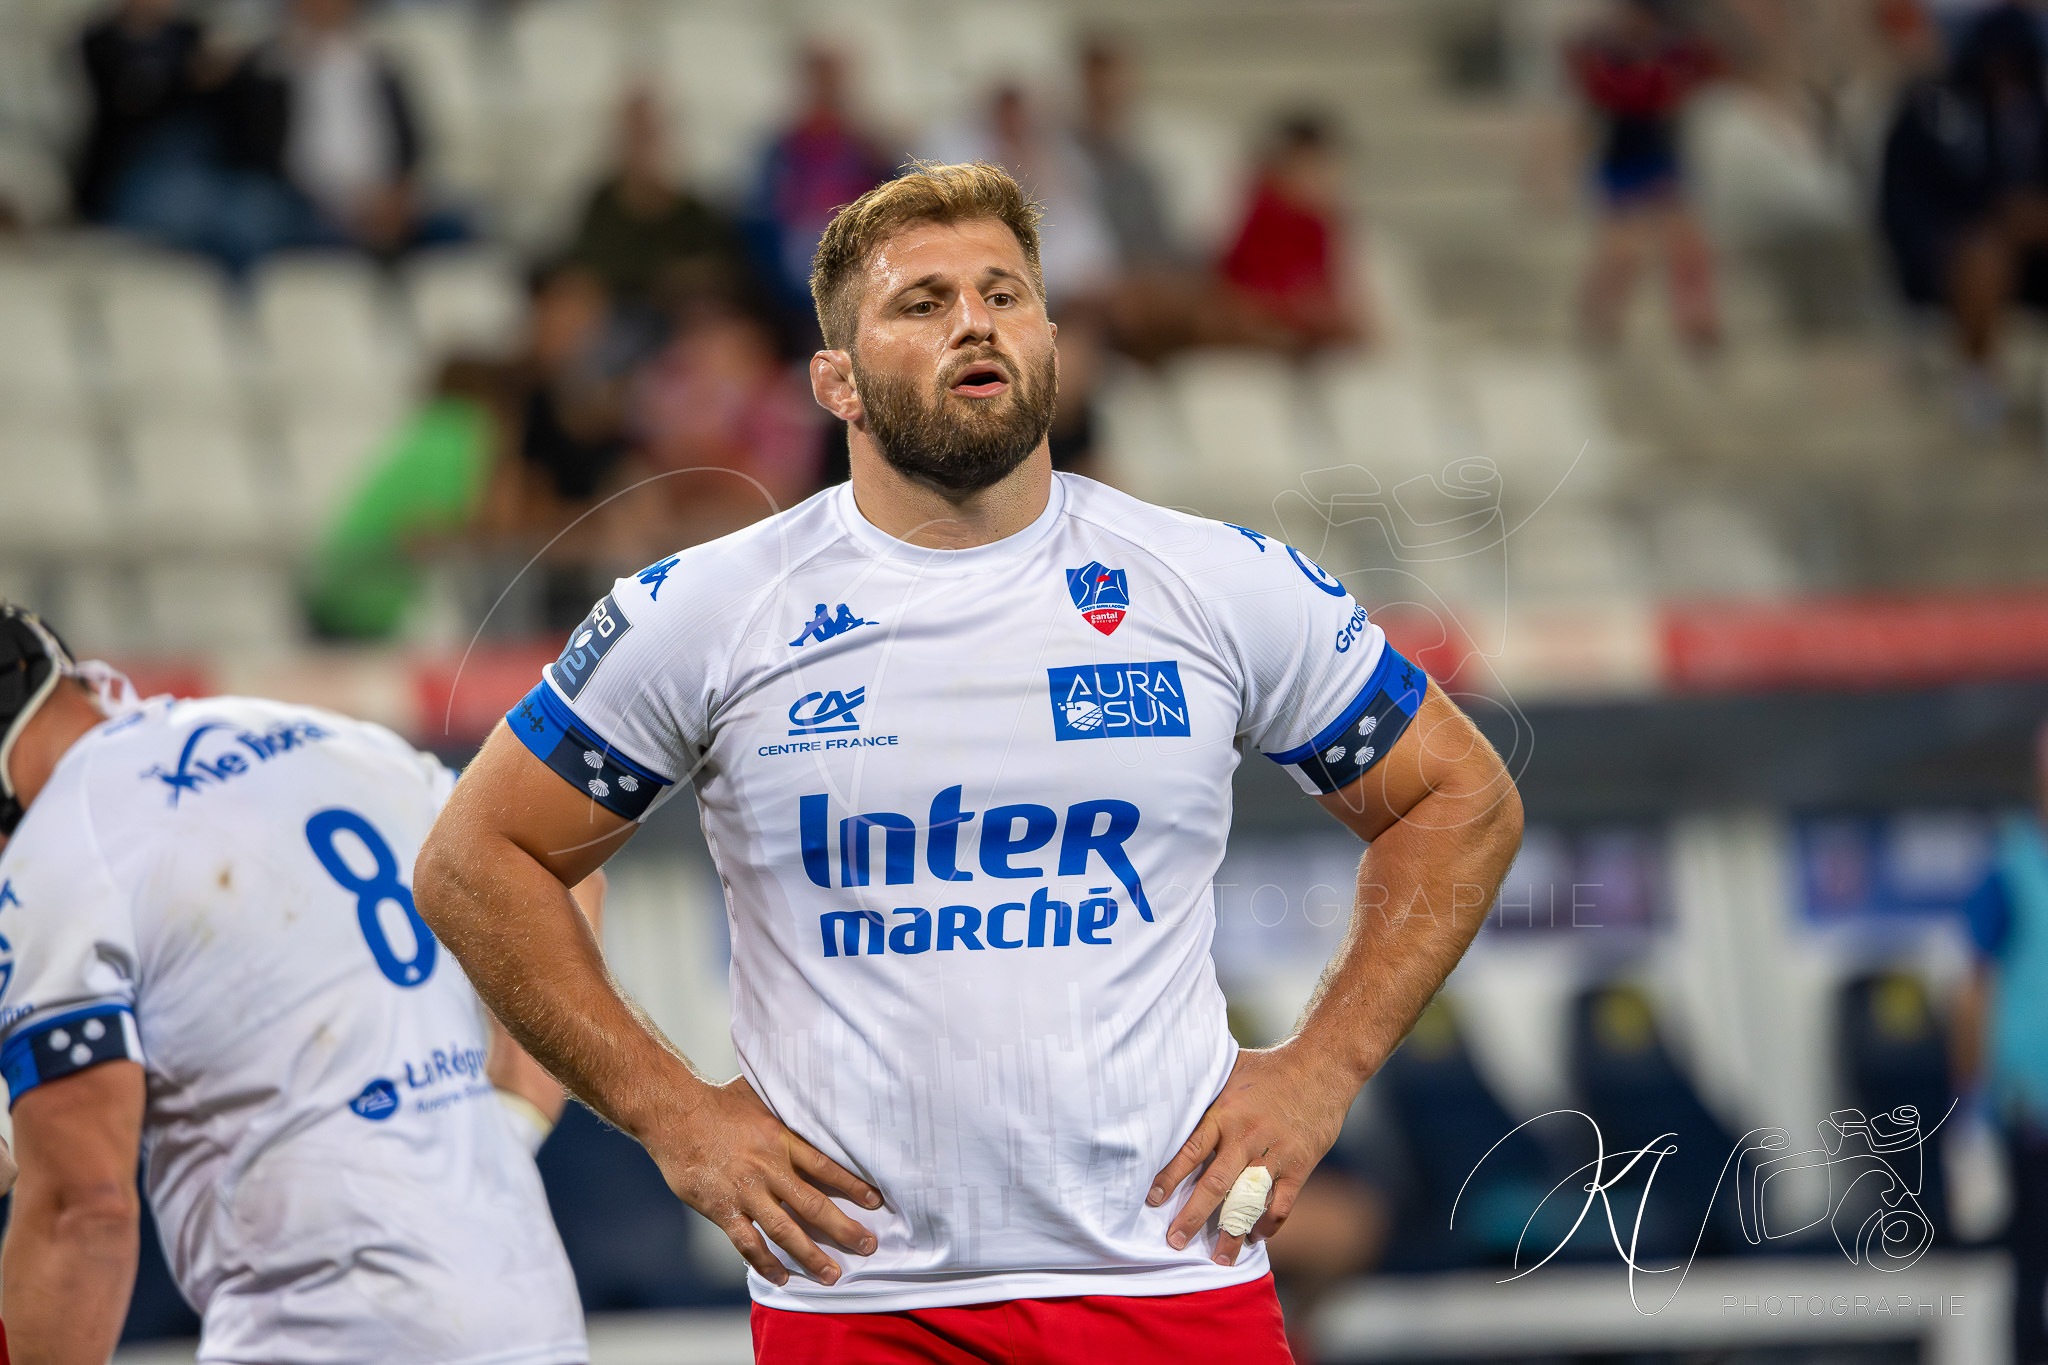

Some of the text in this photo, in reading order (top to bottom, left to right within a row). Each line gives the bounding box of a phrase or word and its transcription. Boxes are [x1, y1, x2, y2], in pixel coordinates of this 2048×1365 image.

[1091, 611, 1118, 620] cantal
[1066, 670, 1180, 701] AURA
[1103, 700, 1185, 728] SUN
[758, 735, 899, 757] CENTRE FRANCE
[305, 808, 438, 989] 8
